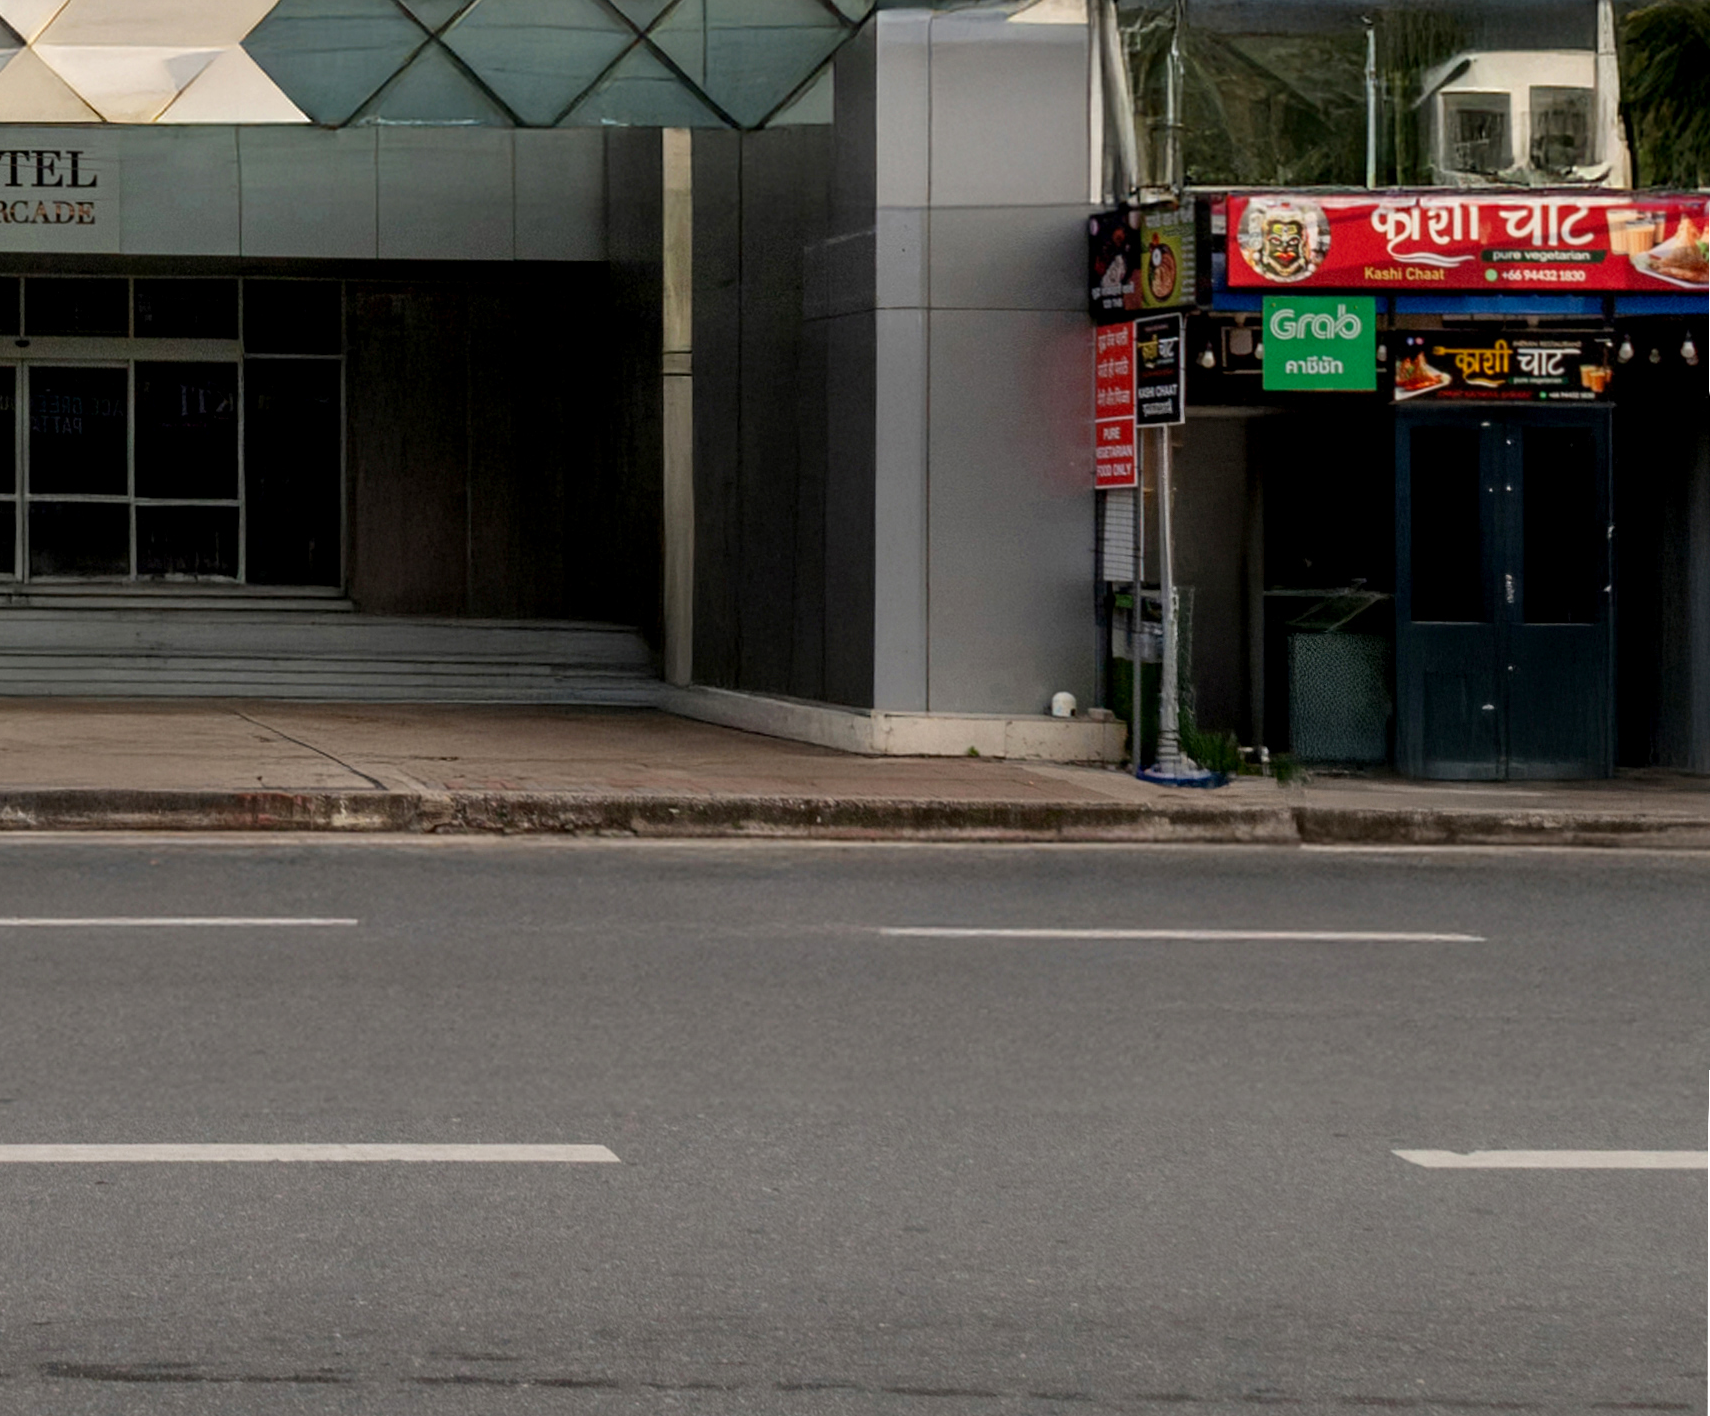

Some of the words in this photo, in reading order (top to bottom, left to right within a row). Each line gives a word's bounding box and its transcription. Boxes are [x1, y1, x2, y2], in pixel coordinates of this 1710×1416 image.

[1492, 250, 1522, 263] pure
[1524, 250, 1591, 262] vegetarian
[1364, 266, 1403, 281] Kashi
[1405, 266, 1445, 281] Chaat
[1270, 303, 1362, 340] Grab
